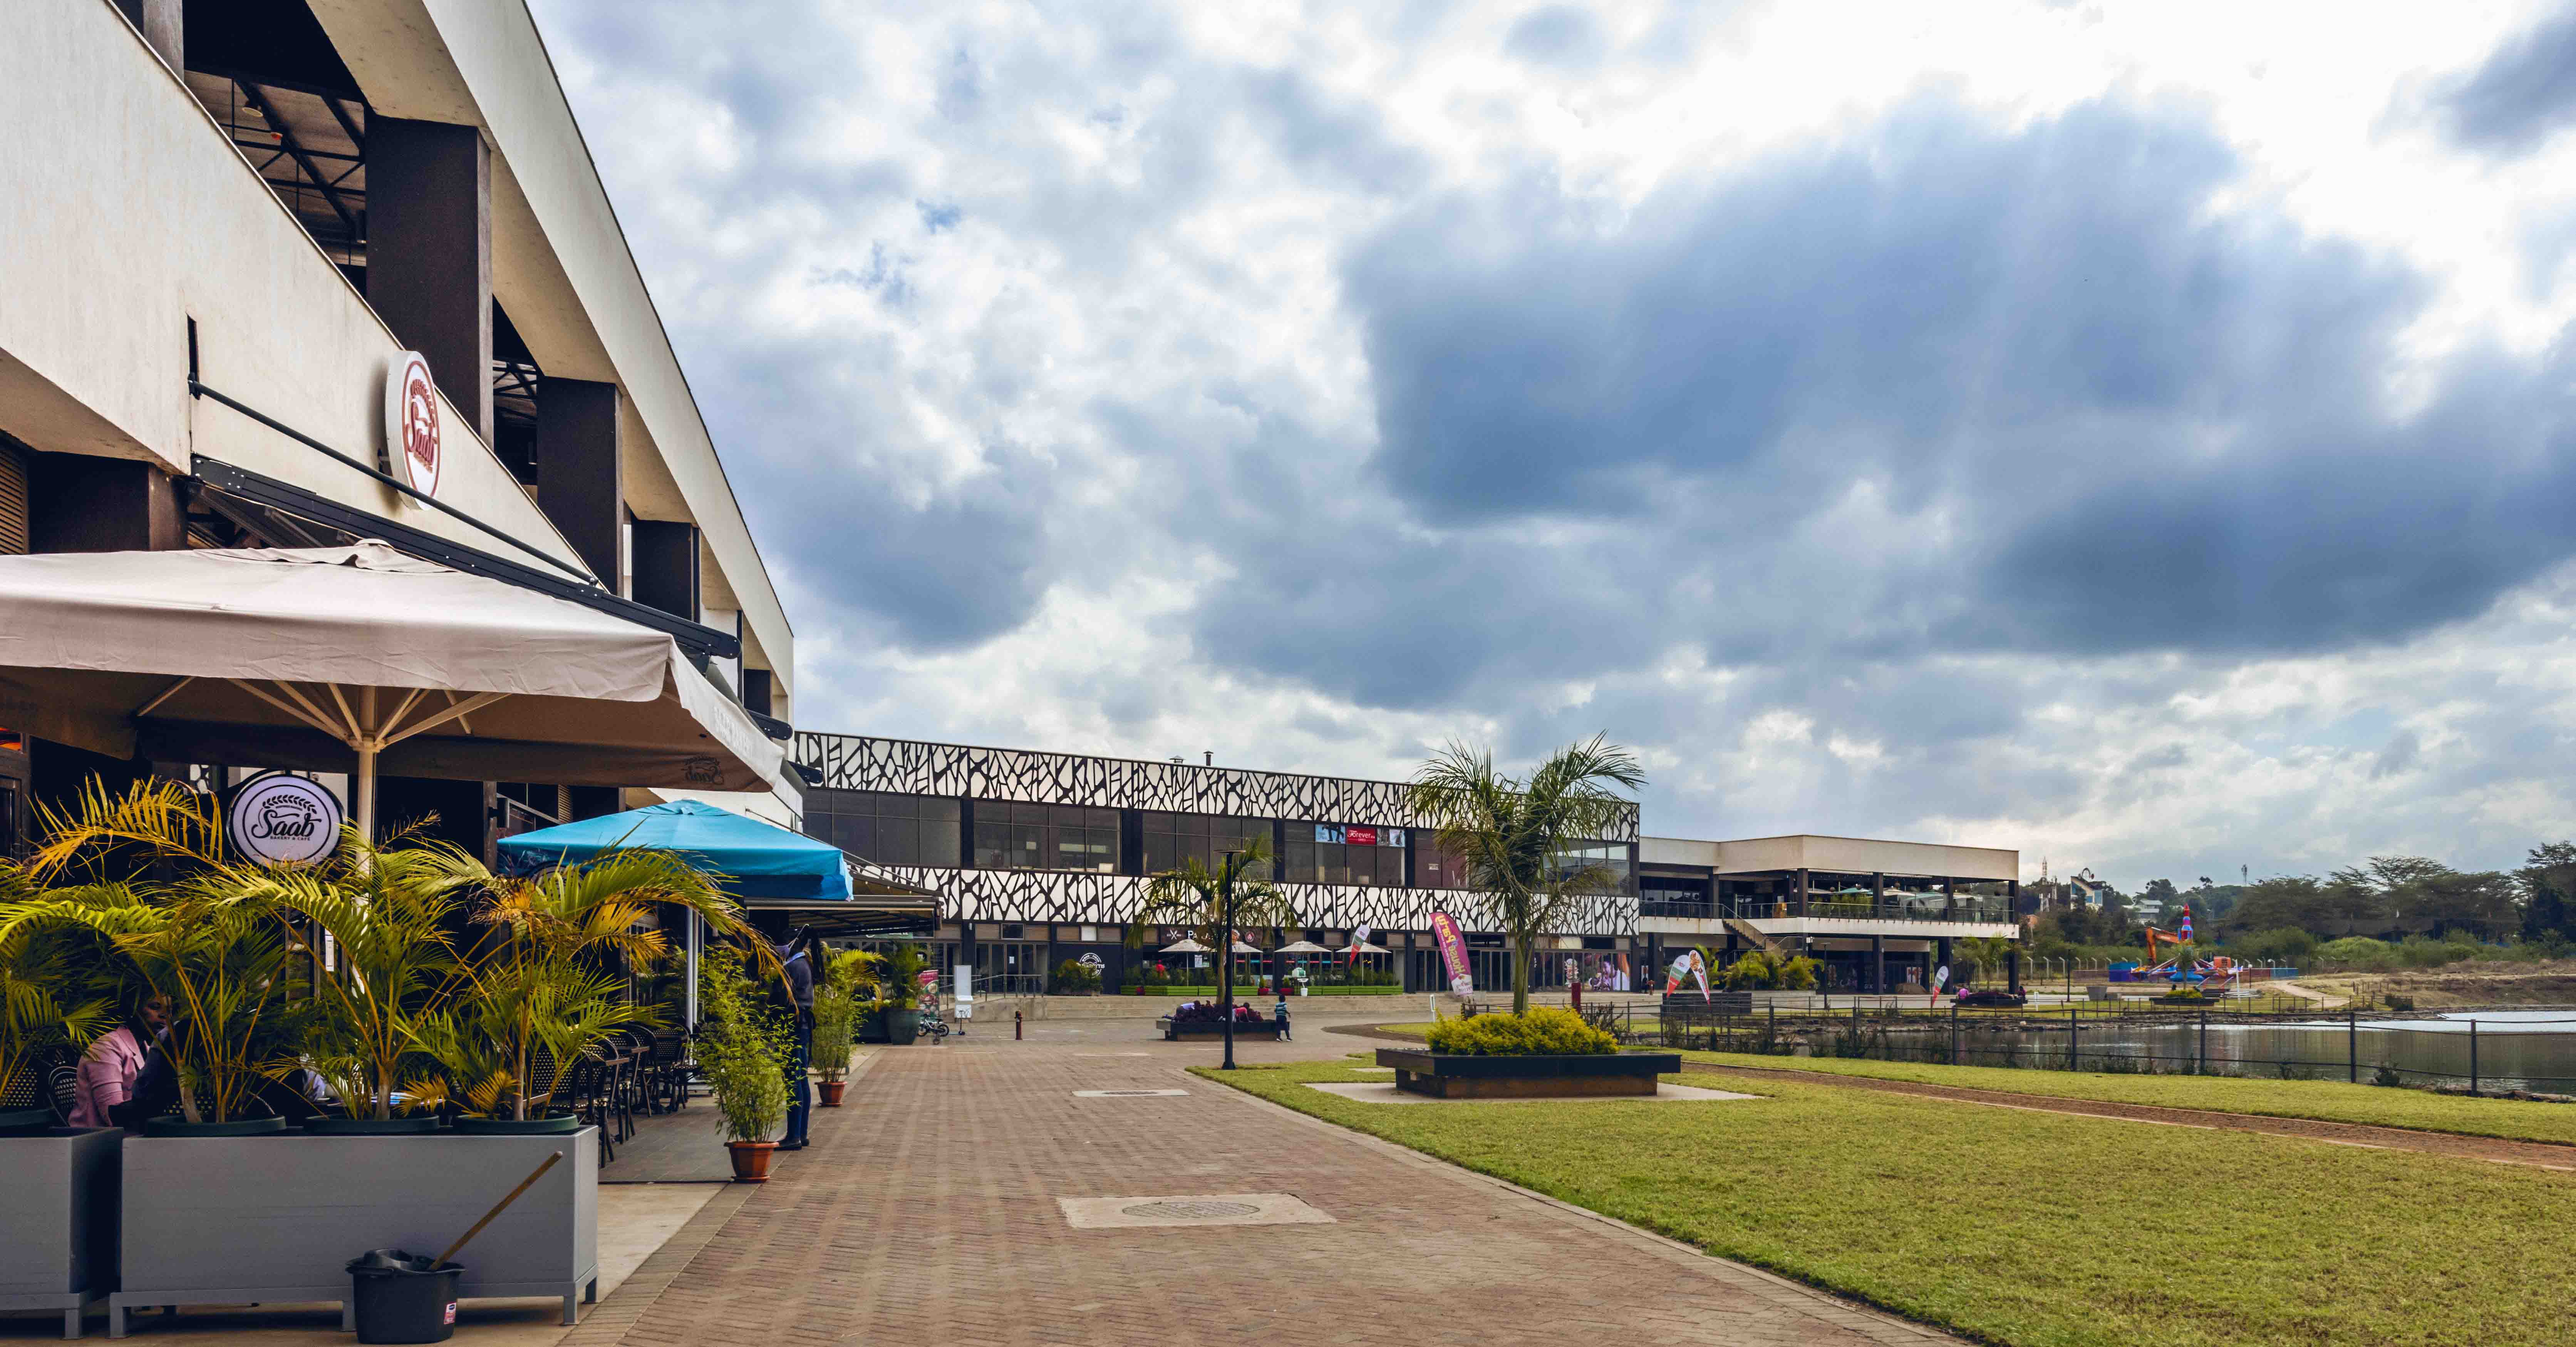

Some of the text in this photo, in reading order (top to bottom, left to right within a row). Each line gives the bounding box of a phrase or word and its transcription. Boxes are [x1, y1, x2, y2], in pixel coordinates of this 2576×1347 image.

[406, 402, 437, 465] Saab
[251, 809, 322, 838] Saab
[1347, 829, 1371, 838] Forever
